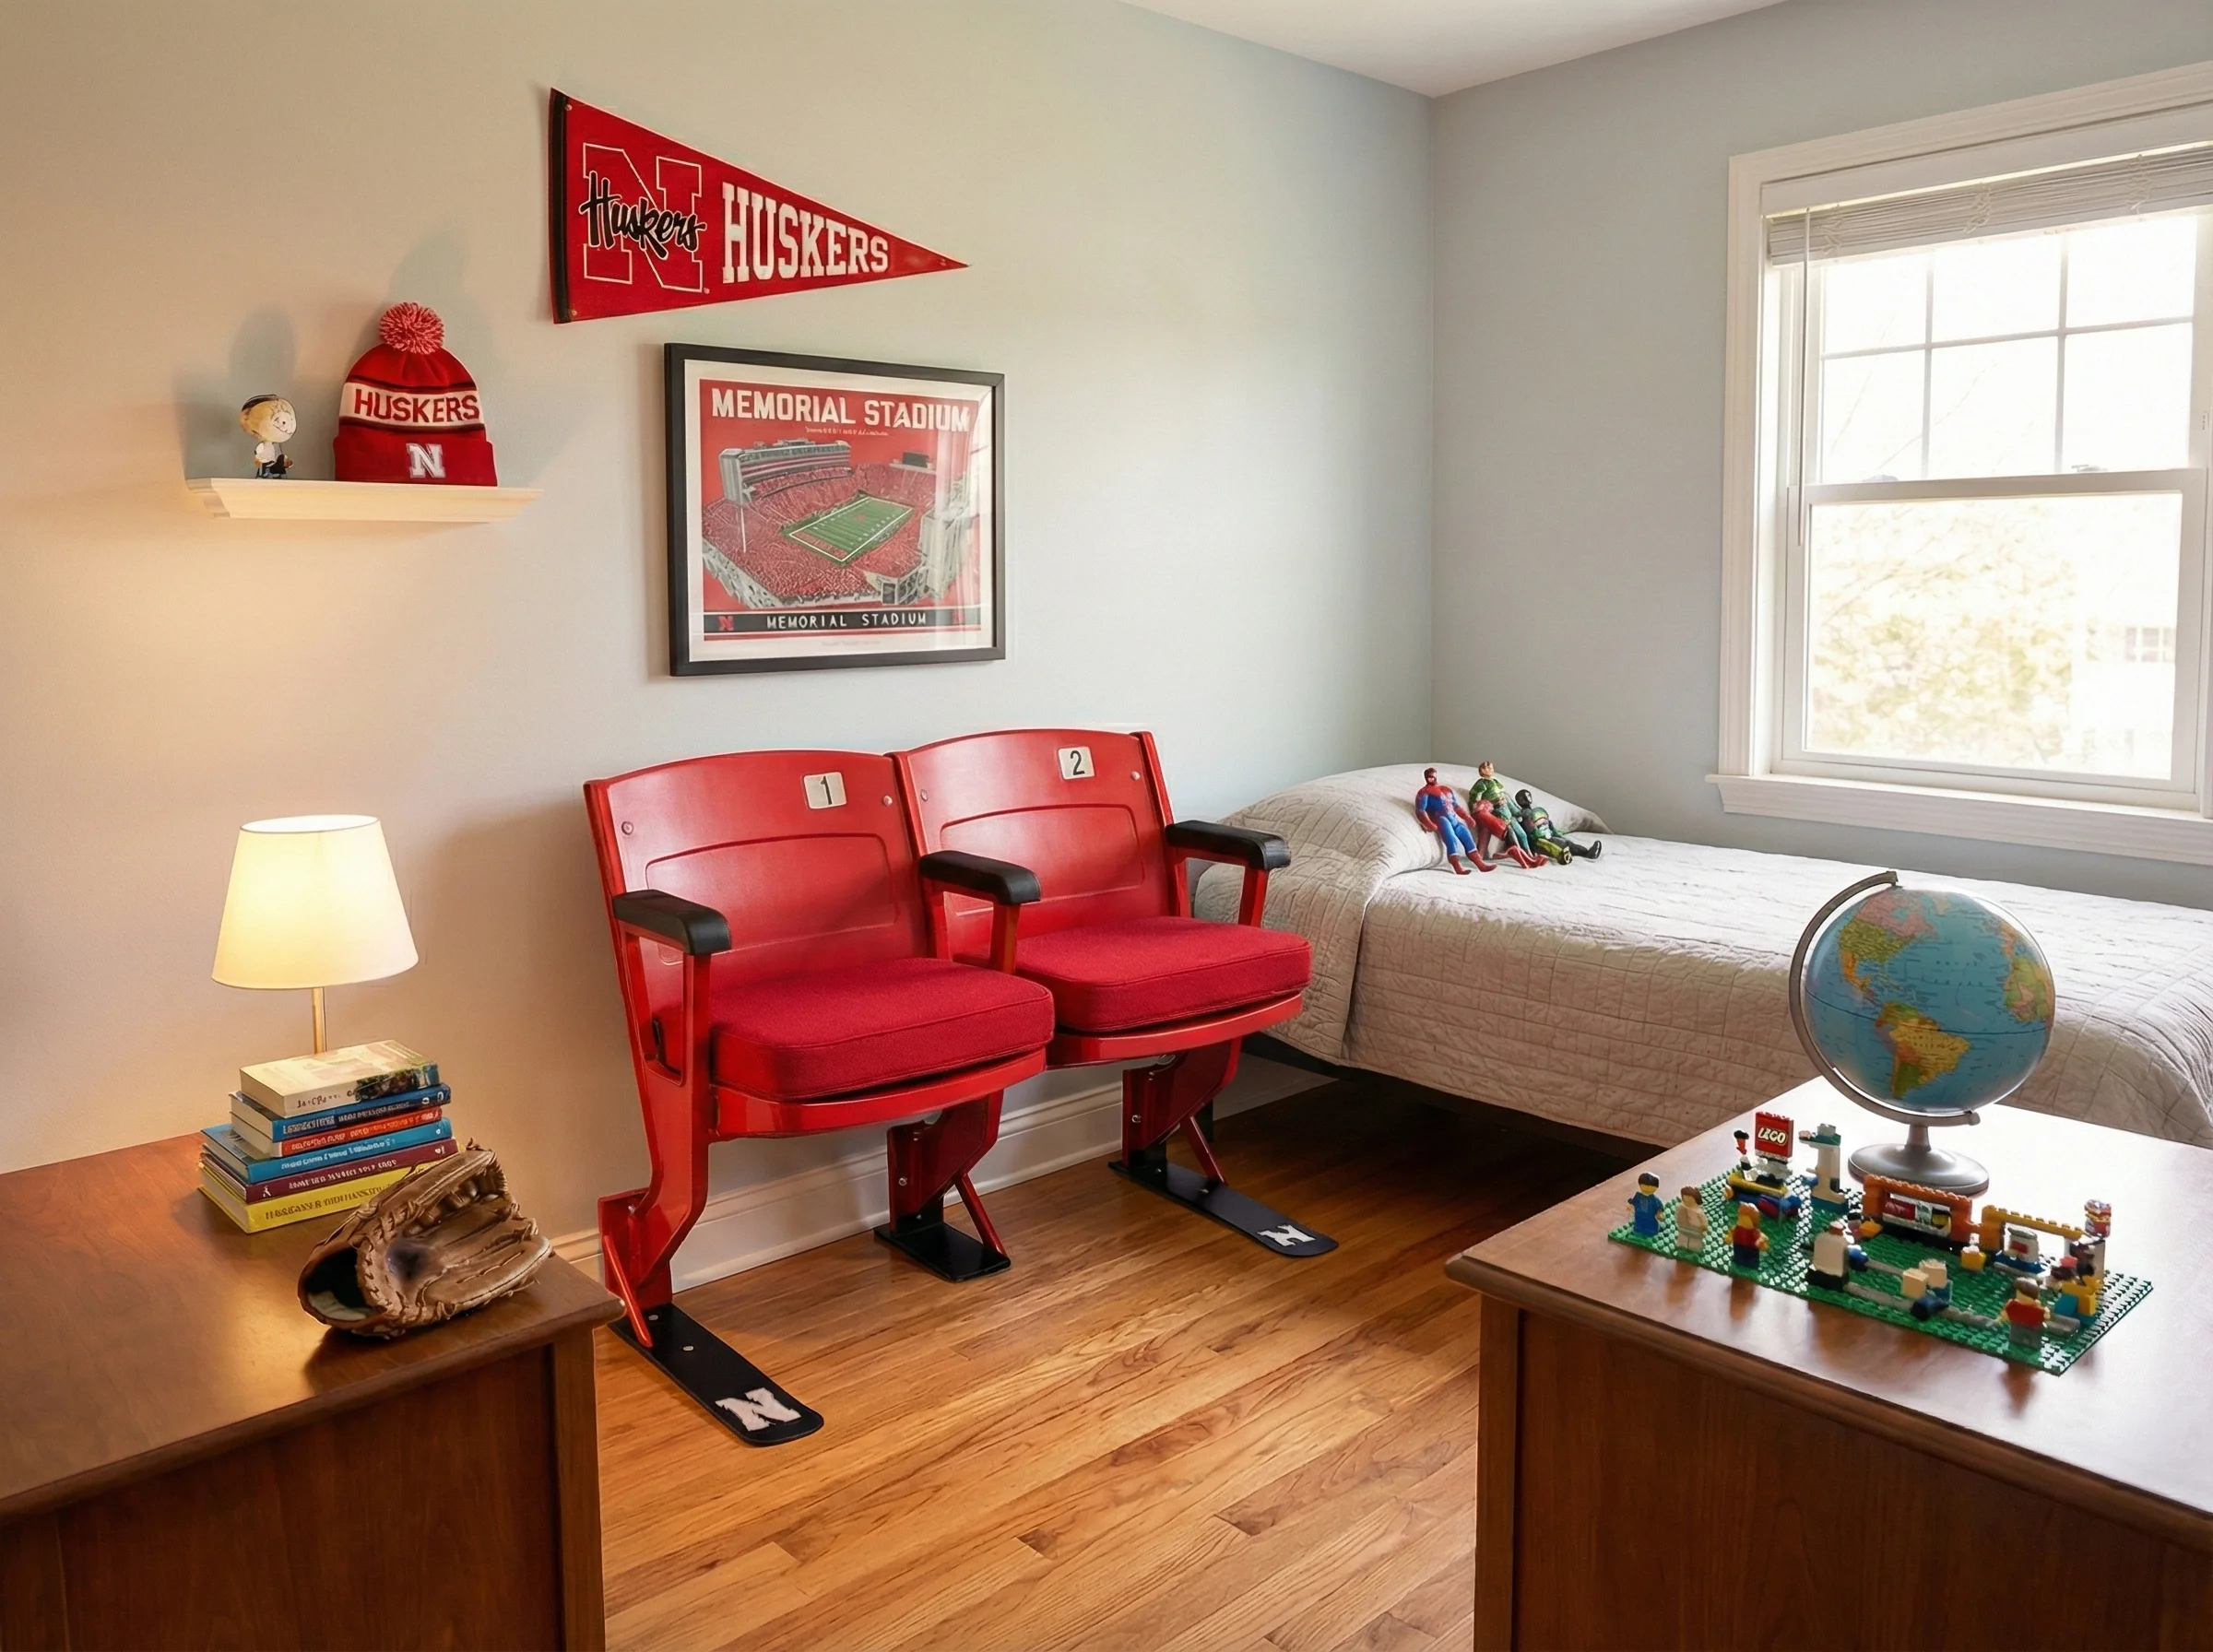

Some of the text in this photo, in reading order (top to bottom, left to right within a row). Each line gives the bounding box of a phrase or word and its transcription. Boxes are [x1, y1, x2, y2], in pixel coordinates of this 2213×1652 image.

[579, 170, 707, 260] Huskers
[721, 181, 890, 285] HUSKERS
[355, 388, 479, 423] HUSKERS
[711, 387, 971, 432] MEMORIAL STADIUM
[407, 442, 446, 478] N
[717, 615, 735, 632] N
[766, 611, 927, 631] MEMORIAL STADIUM
[1070, 749, 1085, 776] 2
[820, 774, 833, 805] 1
[715, 1386, 802, 1433] N
